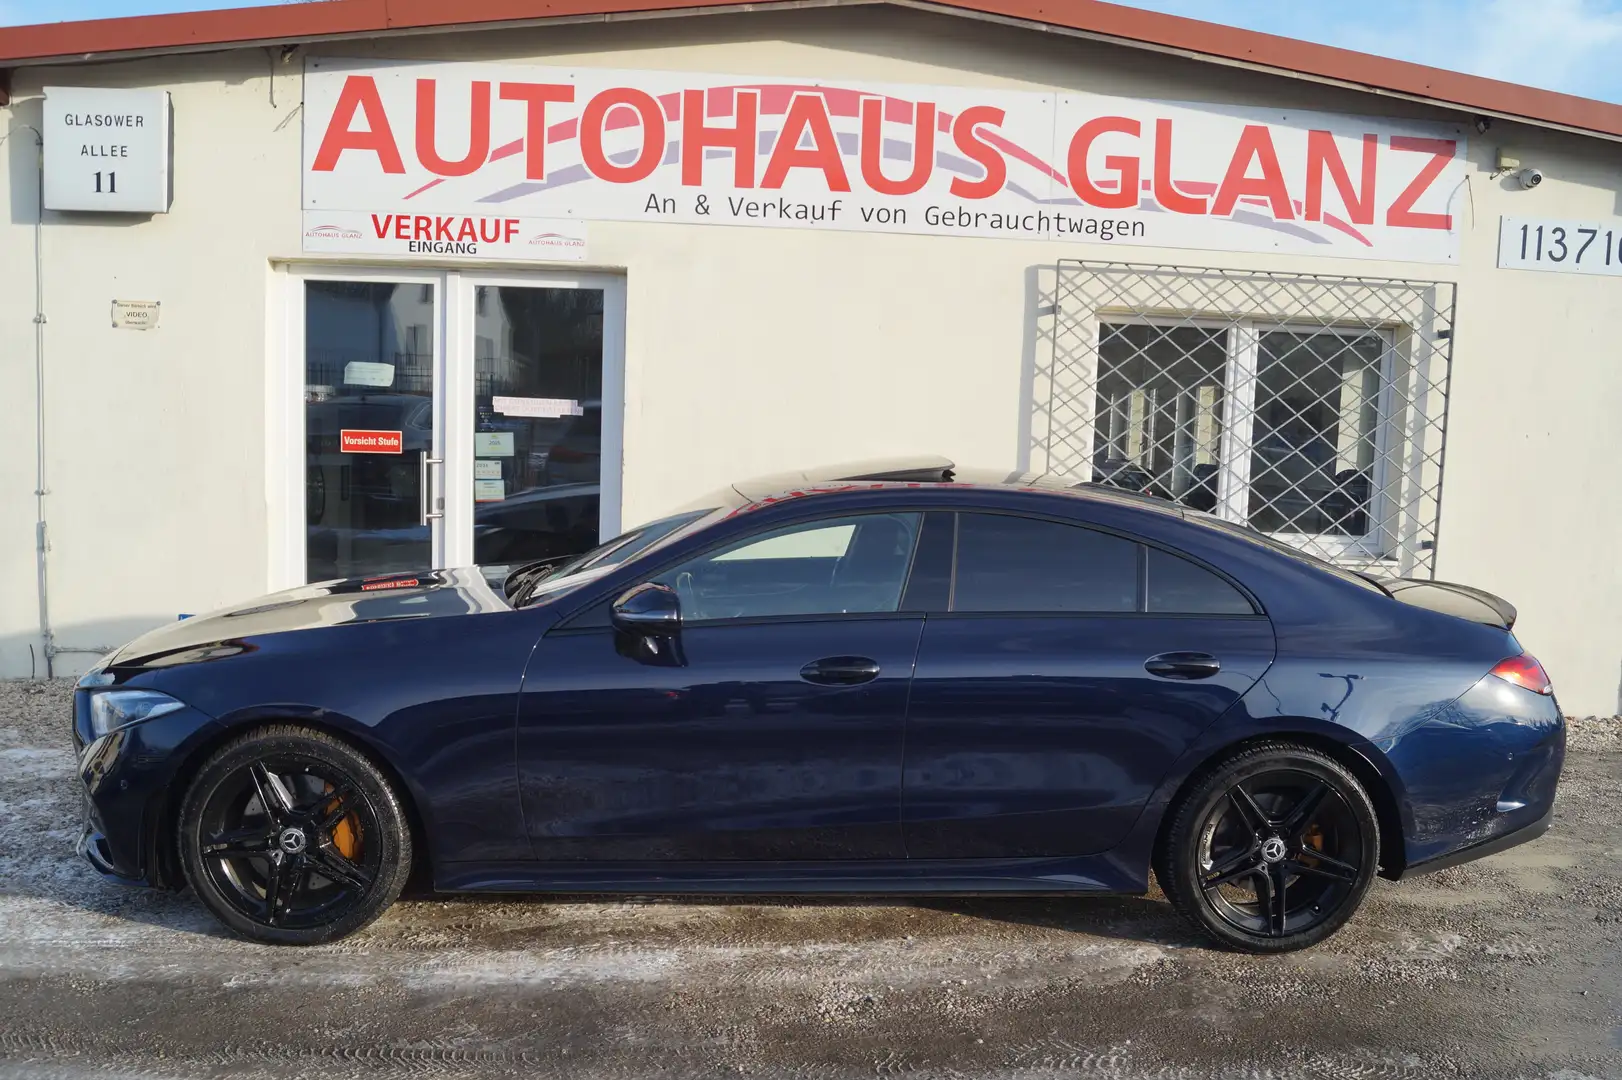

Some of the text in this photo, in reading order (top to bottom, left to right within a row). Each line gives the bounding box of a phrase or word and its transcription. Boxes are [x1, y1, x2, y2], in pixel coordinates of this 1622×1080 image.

[64, 113, 144, 127] GLASOWER
[80, 144, 128, 157] ALLEE
[311, 75, 1457, 230] AUTOHAUS GLANZ
[92, 171, 117, 193] 11
[644, 193, 1145, 240] An & Verkauf von Gebrauchtwagen
[305, 231, 363, 240] AUTOHAUS GLANZ
[371, 213, 520, 244] VERKAUF
[408, 240, 477, 255] EINGANG
[528, 239, 562, 247] AUTOHAUS
[1520, 224, 1622, 266] 11371
[344, 435, 399, 447] Vorsicht Stufe
